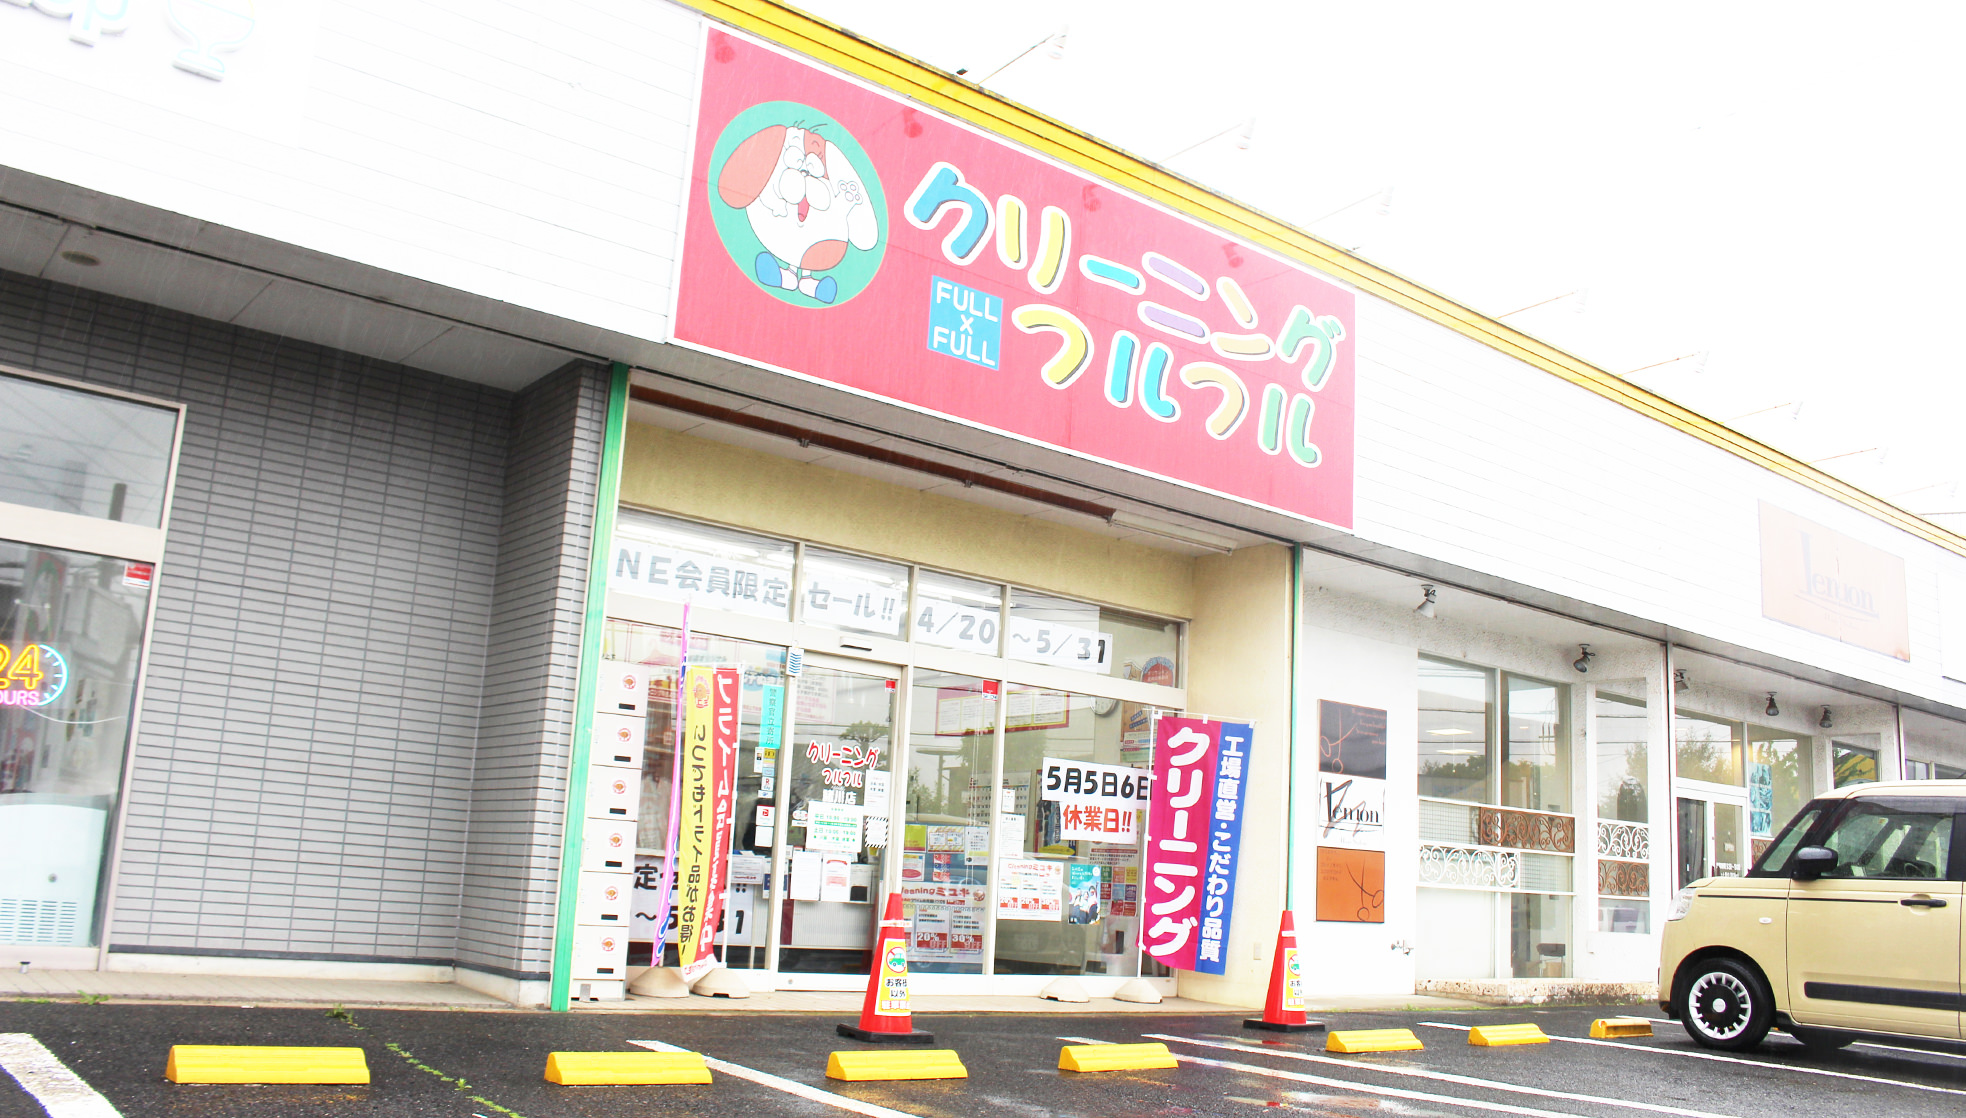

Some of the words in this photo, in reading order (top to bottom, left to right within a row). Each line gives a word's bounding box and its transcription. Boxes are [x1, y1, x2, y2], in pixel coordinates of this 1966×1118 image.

[905, 162, 1346, 391] クリーニング
[936, 281, 998, 322] FULL
[933, 325, 996, 366] FULL
[1012, 303, 1322, 468] フルフル
[917, 606, 996, 645] 4/20
[807, 741, 879, 768] クリーニング
[823, 769, 862, 787] フルフル
[1046, 765, 1152, 801] 5月5日6日
[1063, 804, 1132, 832] 休業日!!
[1148, 726, 1211, 957] クリーニング
[1199, 735, 1244, 963] 工場直営・こだわり品質
[917, 932, 939, 941] 20%
[952, 934, 975, 943] 30%
